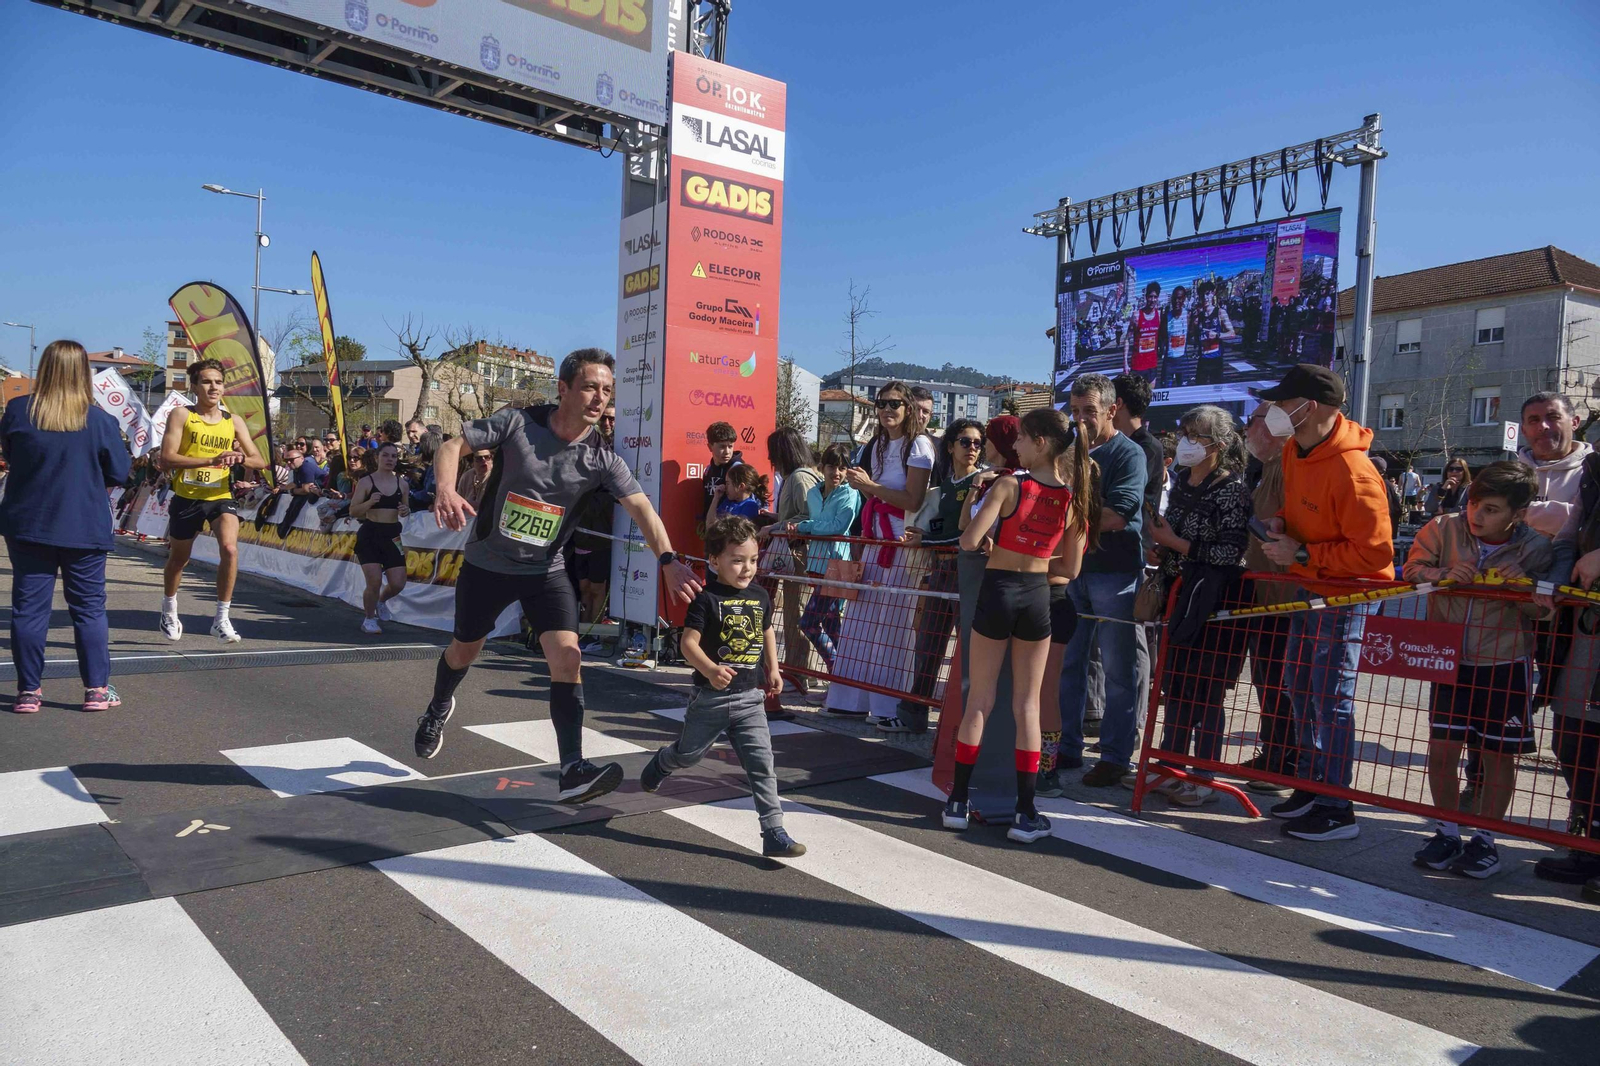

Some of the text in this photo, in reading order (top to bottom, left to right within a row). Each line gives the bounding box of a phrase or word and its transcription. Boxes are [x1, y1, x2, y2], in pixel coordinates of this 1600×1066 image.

[706, 121, 776, 161] LASAL
[686, 175, 771, 218] GADIS
[633, 230, 661, 254] LASAL
[703, 228, 748, 245] RODOSA
[625, 267, 659, 293] GADIS
[709, 263, 761, 281] ELECPOR
[696, 301, 723, 313] Grupo
[689, 311, 754, 328] Godoy Maceira
[631, 331, 656, 344] ELECOR
[690, 351, 740, 368] NaturGas
[705, 392, 755, 410] CEAMSA
[1152, 391, 1170, 402] NDEZ
[190, 431, 199, 444] EL
[200, 433, 231, 451] CANARIO
[197, 470, 211, 482] 88
[507, 509, 554, 539] 2269
